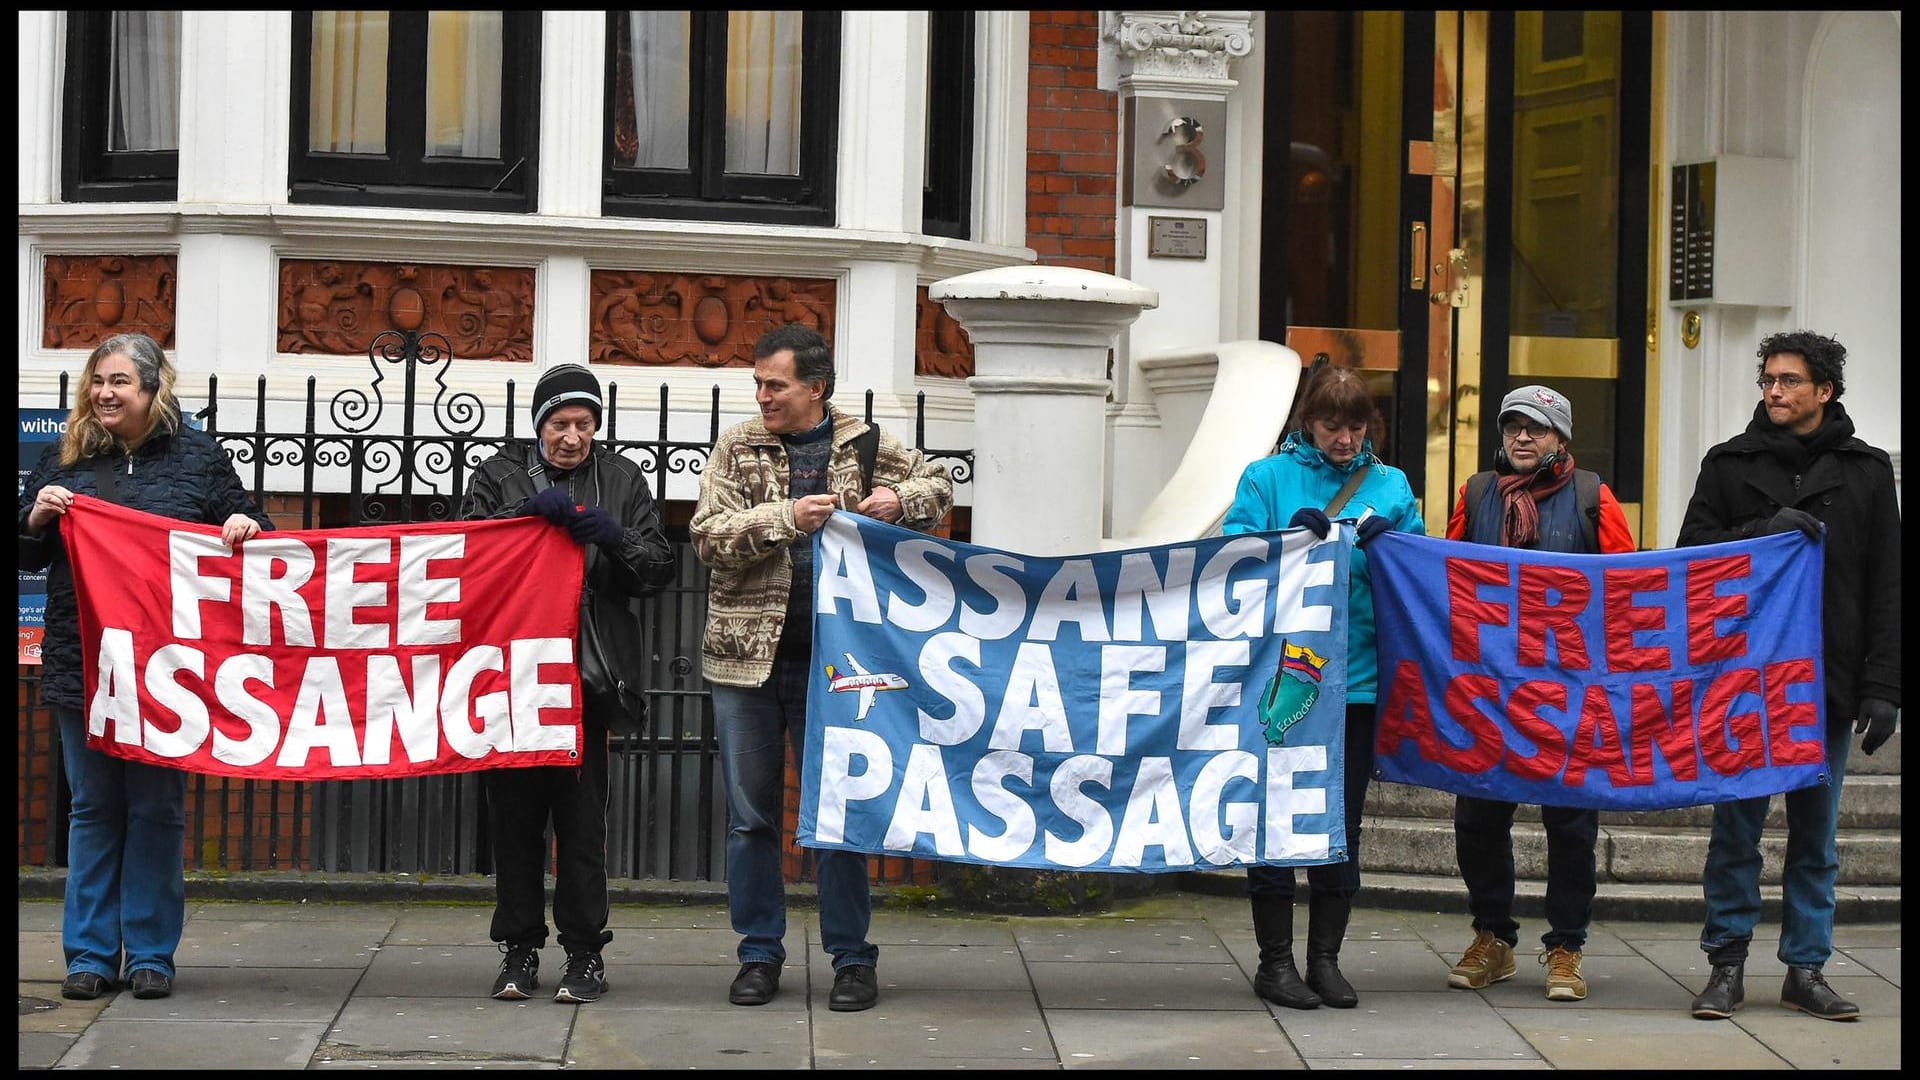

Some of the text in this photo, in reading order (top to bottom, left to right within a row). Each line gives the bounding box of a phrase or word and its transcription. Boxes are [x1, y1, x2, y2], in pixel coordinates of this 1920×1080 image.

[1159, 117, 1206, 187] 3
[169, 530, 466, 649] FREE
[816, 512, 1340, 641] ASSANGE
[1446, 555, 1751, 673] FREE
[89, 627, 577, 768] ASSANGE
[917, 633, 1250, 756] SAFE
[1276, 692, 1316, 732] Ecuador
[1376, 659, 1823, 788] ASSANGE
[815, 727, 1331, 868] PASSAGE
